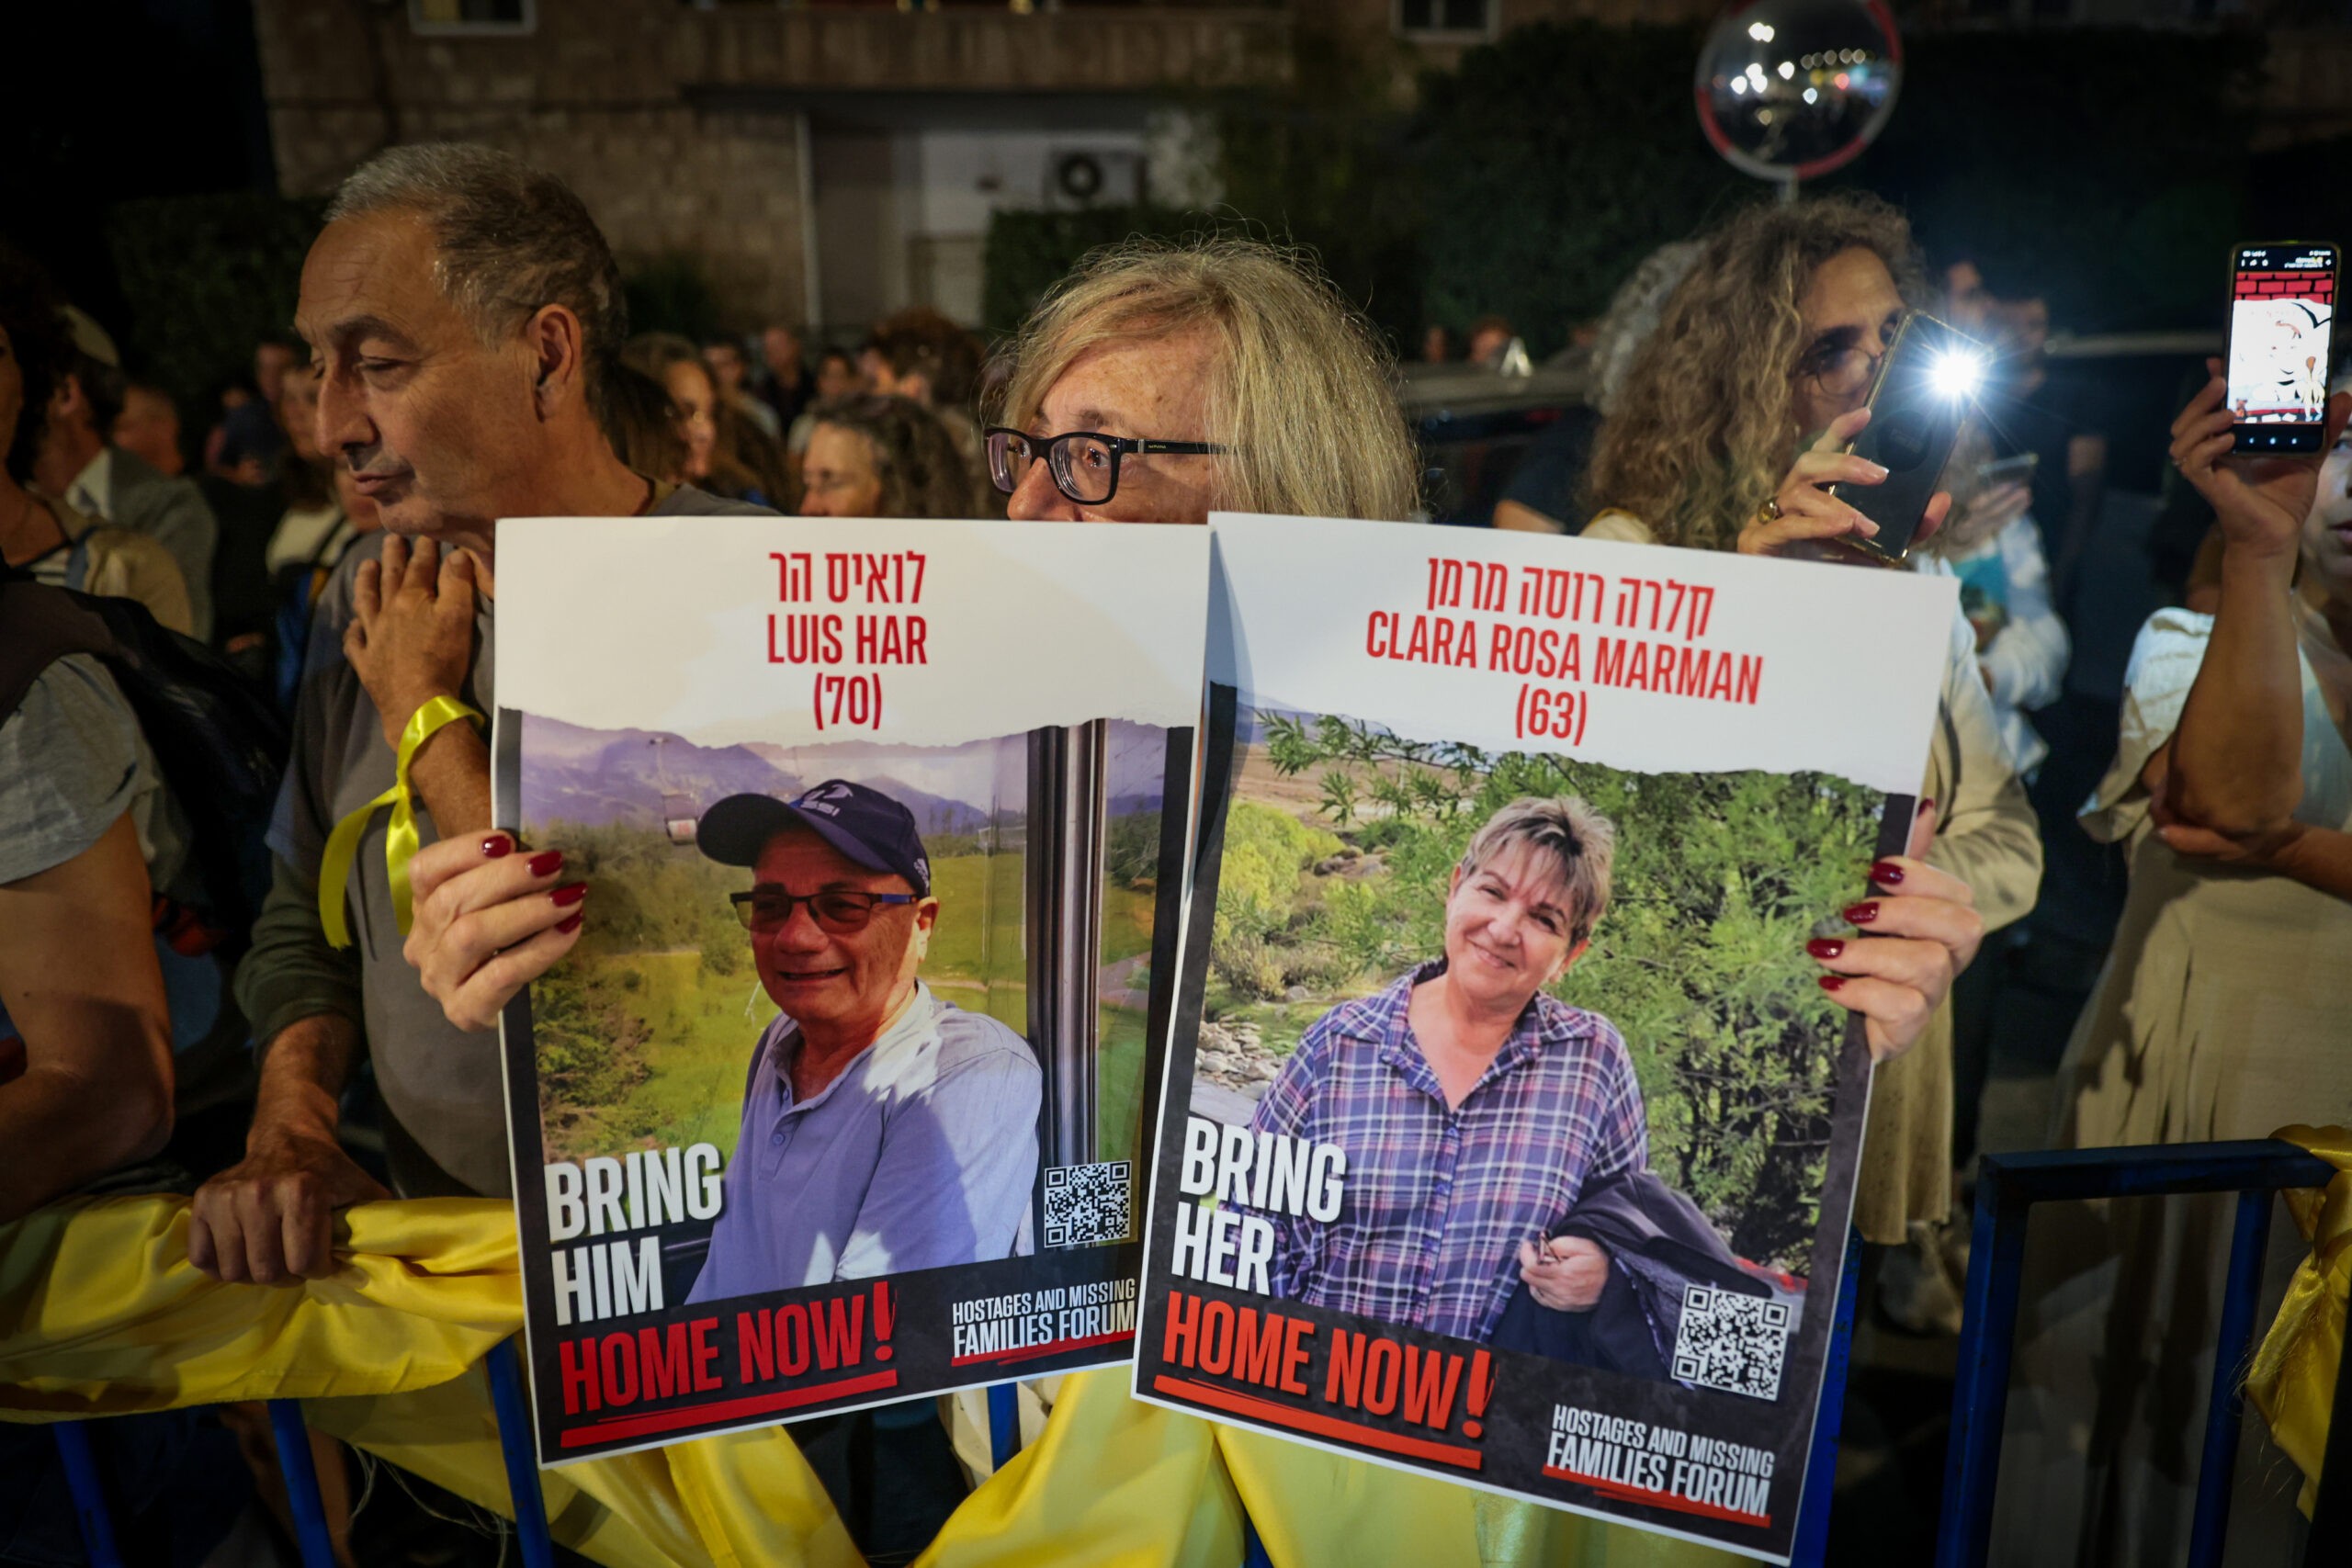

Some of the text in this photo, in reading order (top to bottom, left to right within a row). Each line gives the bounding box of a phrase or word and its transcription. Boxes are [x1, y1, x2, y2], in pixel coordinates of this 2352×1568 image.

[769, 550, 926, 604] לואיס הר
[1427, 558, 1715, 641] קלרה רוסה מרמן
[767, 614, 928, 664] LUIS HAR
[1366, 610, 1763, 705] CLARA ROSA MARMAN
[813, 672, 883, 730] (70)
[1516, 683, 1588, 746] (63)
[544, 1143, 722, 1242] BRING
[1180, 1116, 1348, 1223] BRING
[551, 1235, 664, 1326] HIM
[1171, 1201, 1274, 1296] HER
[953, 1278, 1136, 1325] HOSTAGES AND MISSING
[954, 1300, 1135, 1359] FAMILIES FORUM
[559, 1280, 898, 1416] HOME NOW!
[1162, 1291, 1498, 1439] HOME NOW!
[1547, 1431, 1771, 1517] FAMILIES FORUM
[1552, 1404, 1775, 1478] HOSTAGES AND MISSING
